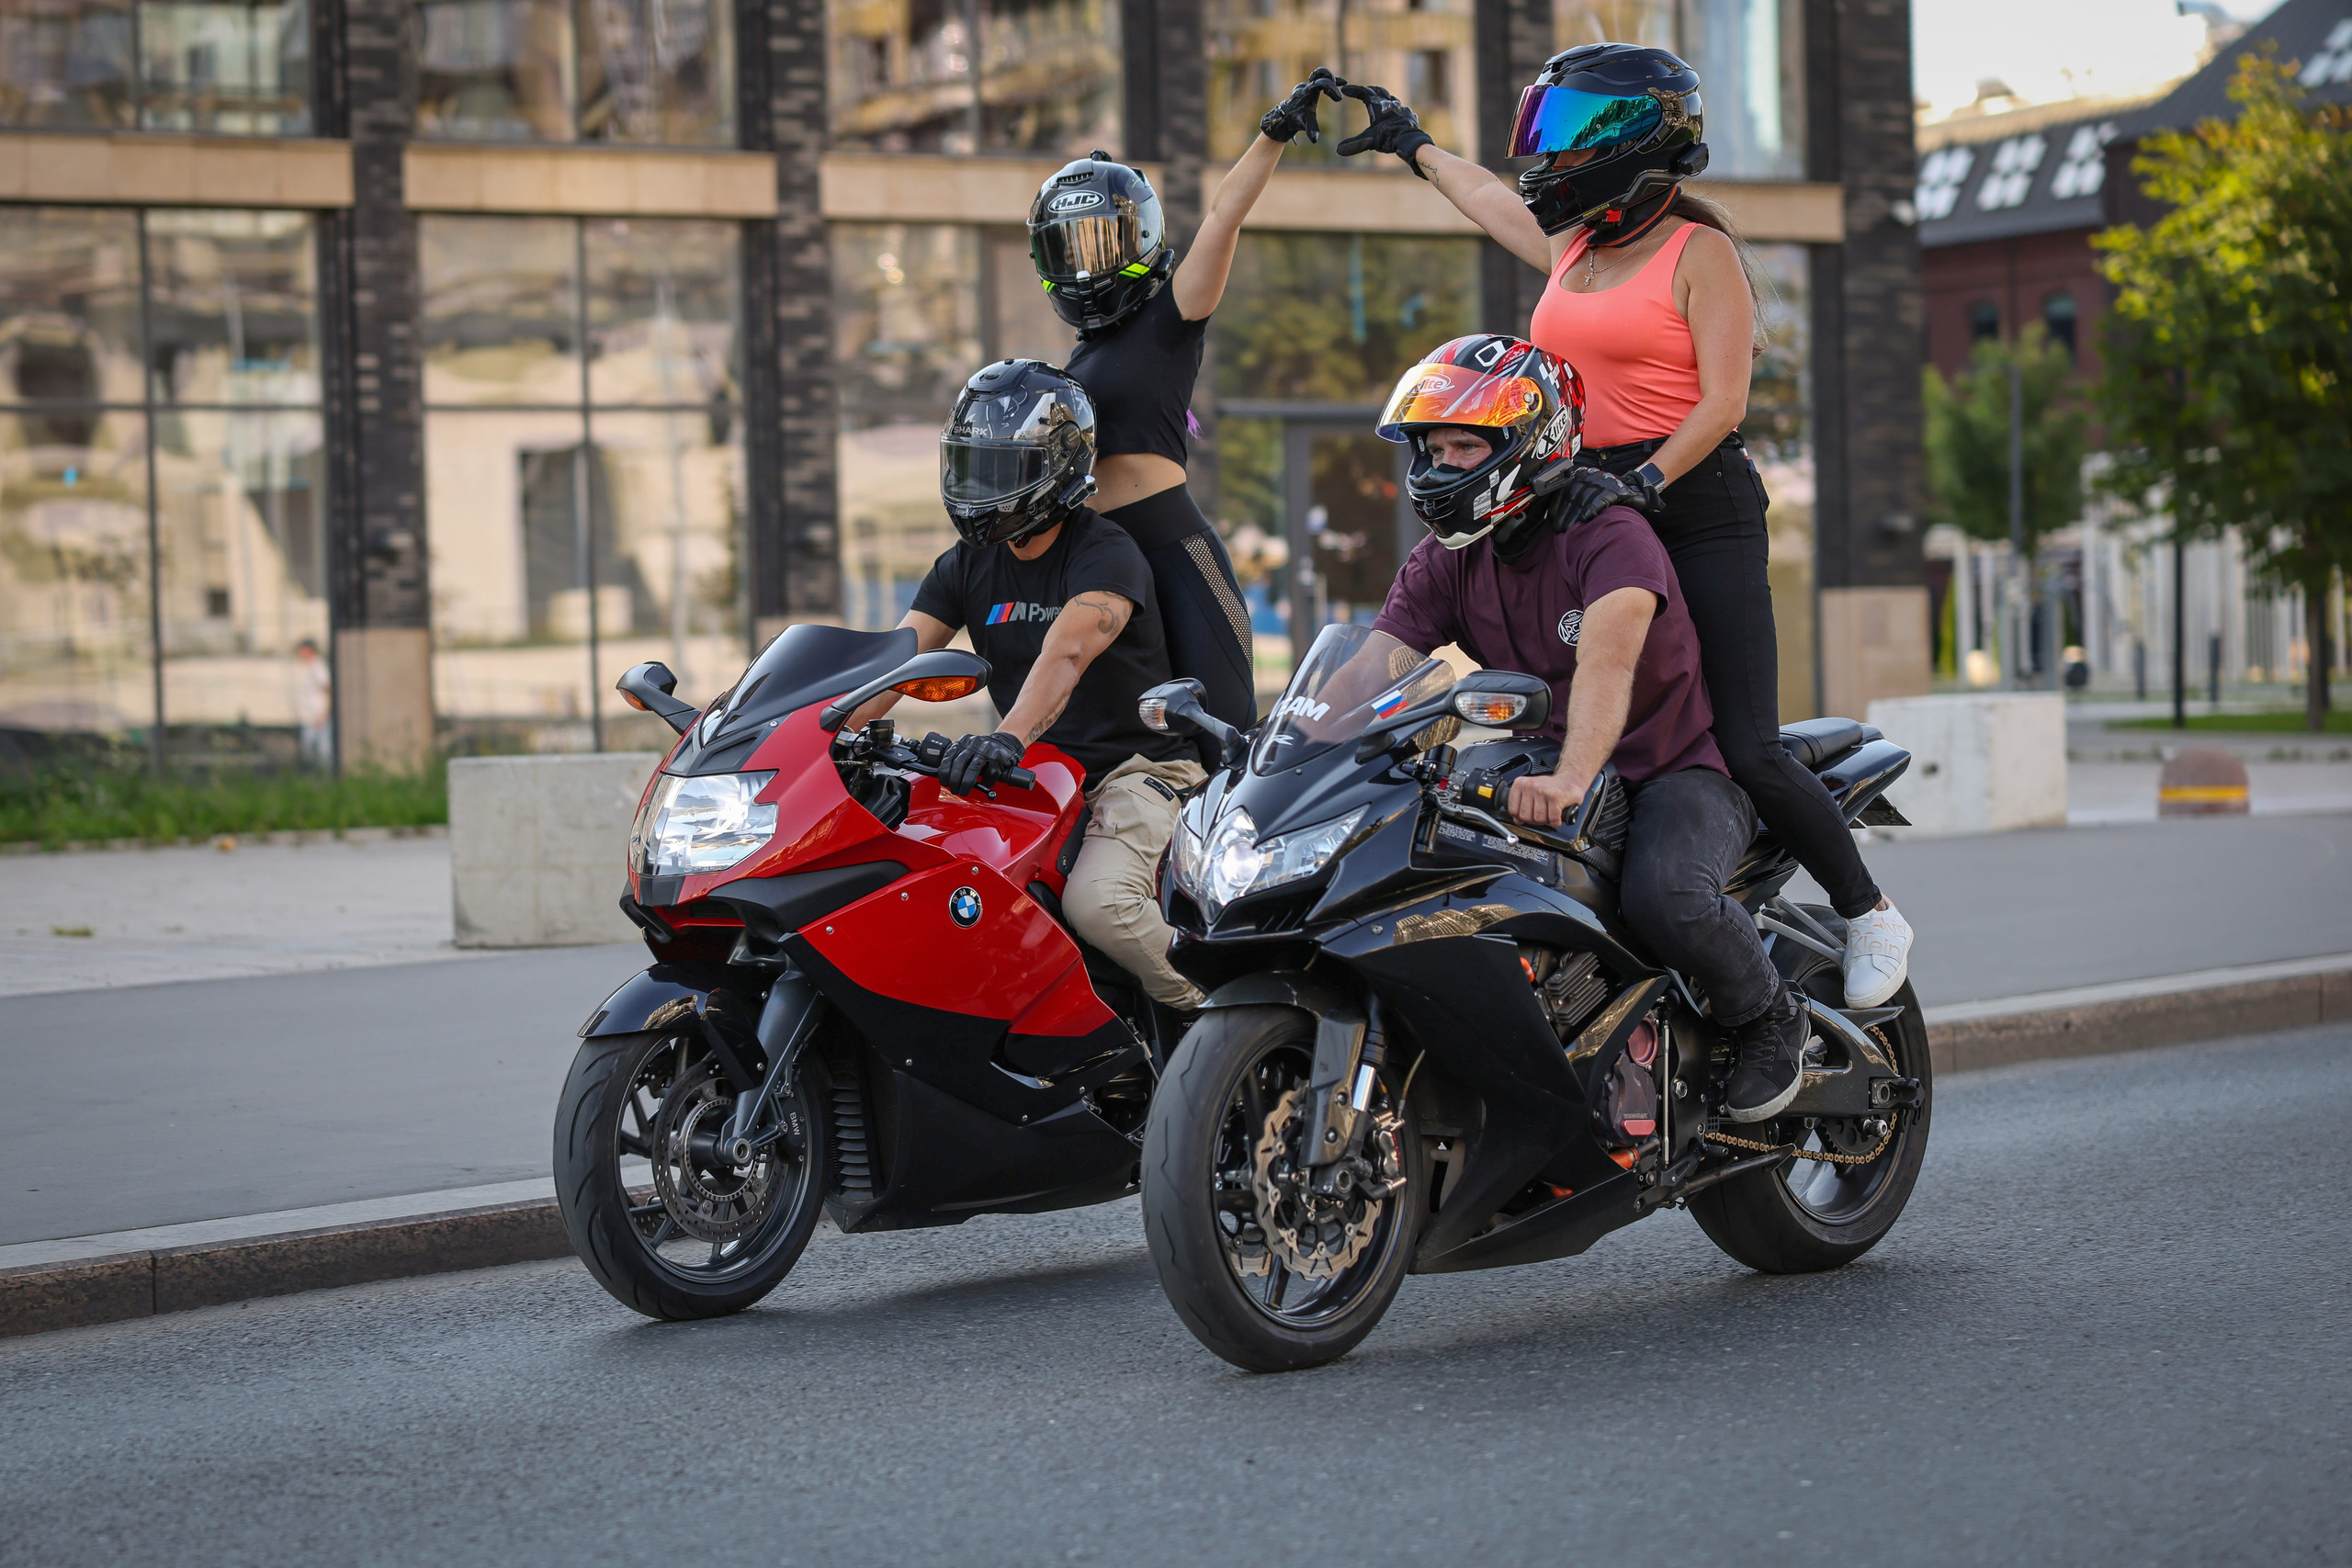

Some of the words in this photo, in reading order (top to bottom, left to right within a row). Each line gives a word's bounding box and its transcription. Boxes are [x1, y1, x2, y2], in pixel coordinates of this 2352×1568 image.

[1054, 193, 1097, 209] HJC
[953, 425, 989, 436] SHARK
[1541, 412, 1566, 457] X-lite
[1028, 603, 1063, 622] Powe
[1561, 622, 1582, 640] ARC
[952, 888, 977, 904] BMW
[1849, 935, 1901, 957] Klein
[790, 1111, 800, 1135] BMW
